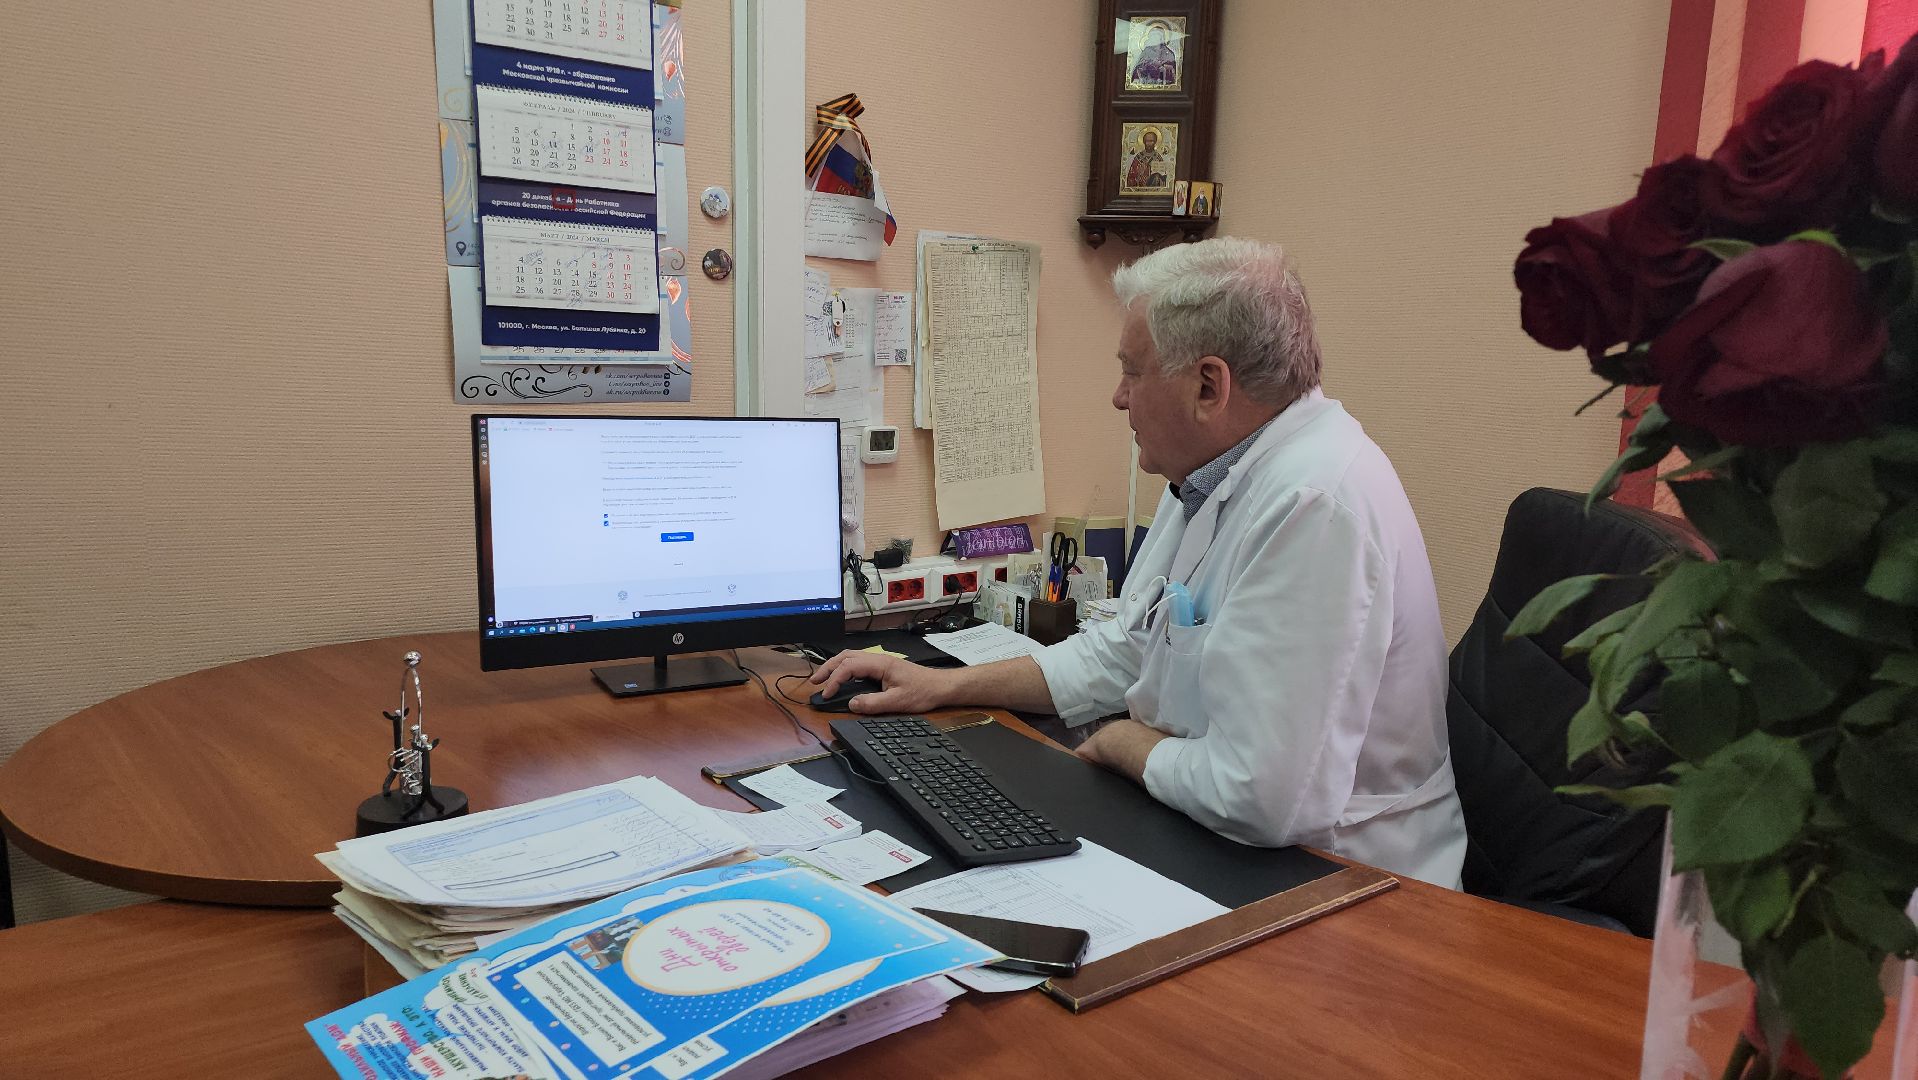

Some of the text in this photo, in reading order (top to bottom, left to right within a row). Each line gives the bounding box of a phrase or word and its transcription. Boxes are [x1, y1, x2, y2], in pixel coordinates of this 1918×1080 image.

[502, 68, 629, 94] Московской чрезвычайной комиссии
[522, 192, 530, 200] 20
[666, 926, 739, 974] открытых
[698, 926, 750, 956] дверей
[658, 948, 702, 973] Дни
[417, 1054, 446, 1078] НАШИ
